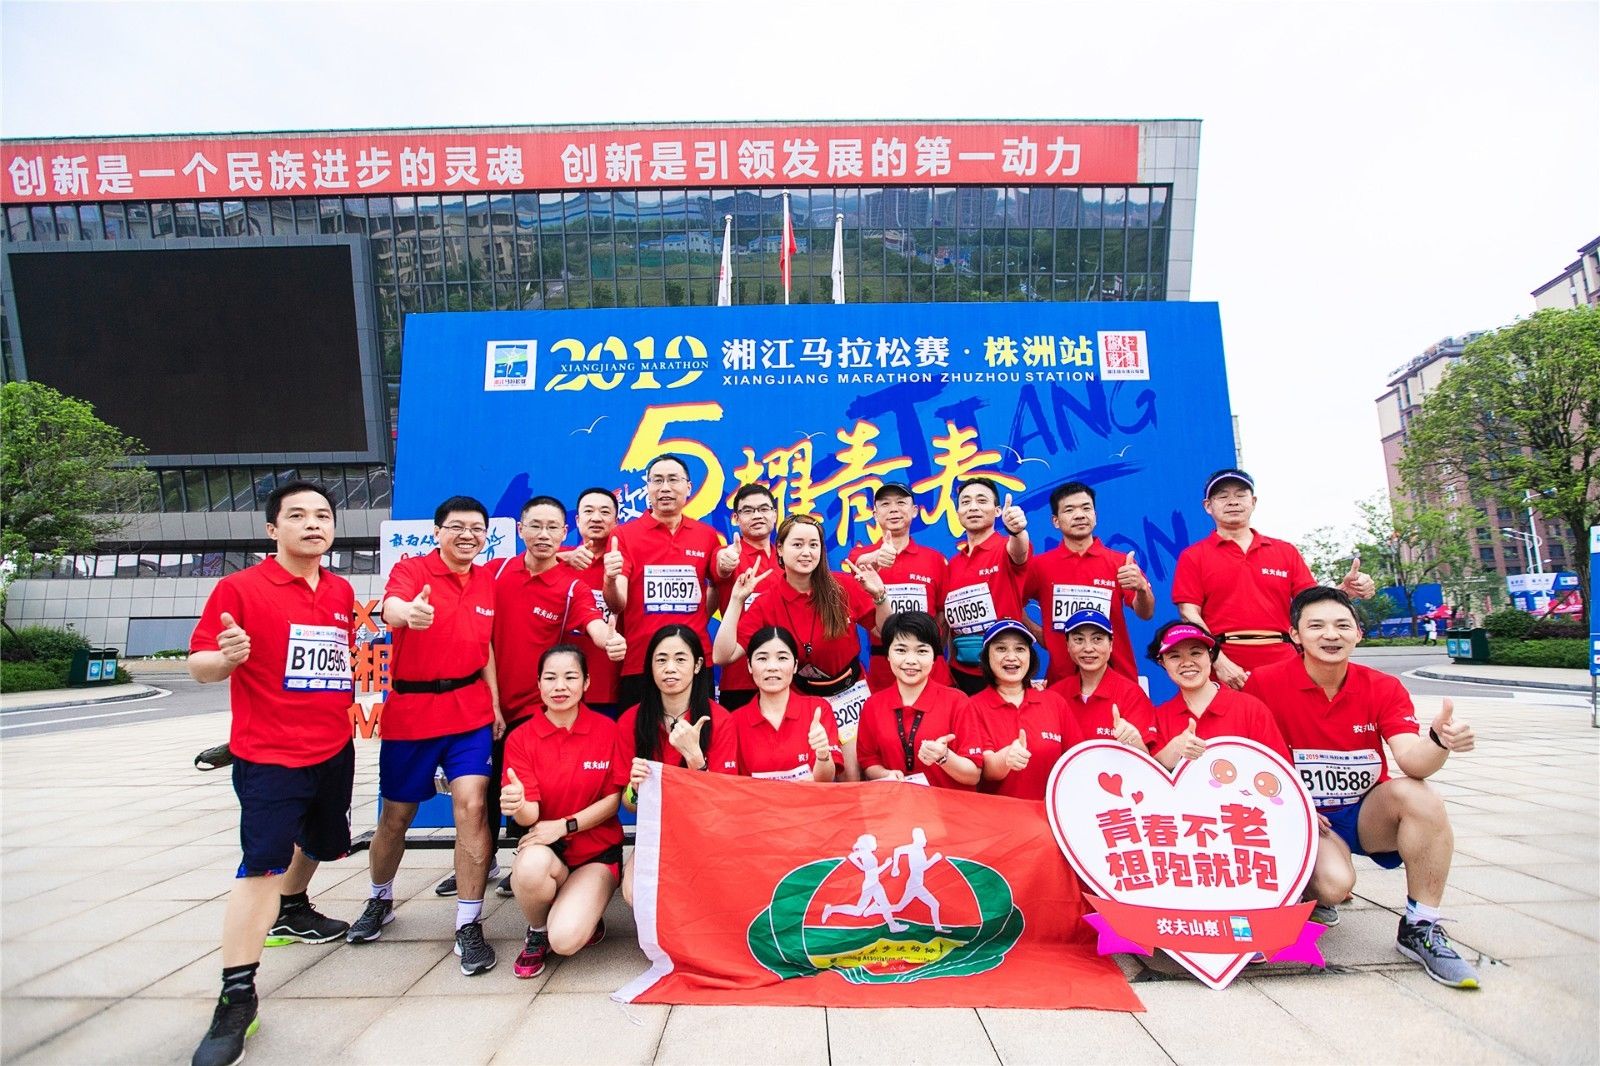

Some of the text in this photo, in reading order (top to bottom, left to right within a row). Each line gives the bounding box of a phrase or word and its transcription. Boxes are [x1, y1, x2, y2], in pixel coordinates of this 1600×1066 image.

[8, 136, 1081, 196] 创新是一个民族进步的灵魂 创新是引领发展的第一动力
[544, 336, 708, 392] 2019
[560, 360, 710, 373] XIANGJIANG MARATHON
[722, 374, 829, 386] XIANGJIANG
[837, 372, 933, 384] MARATHON
[941, 371, 1021, 383] ZHUZHOU
[1025, 370, 1095, 382] STATION
[647, 581, 694, 599] B10597
[890, 599, 921, 614] 0590
[946, 600, 987, 625] B10595
[291, 645, 346, 673] B10596
[1300, 769, 1371, 791] B10588
[1095, 803, 1271, 849] 青春不老
[1105, 848, 1279, 892] 想跑就跑
[1156, 918, 1220, 937] 农夫山泉
